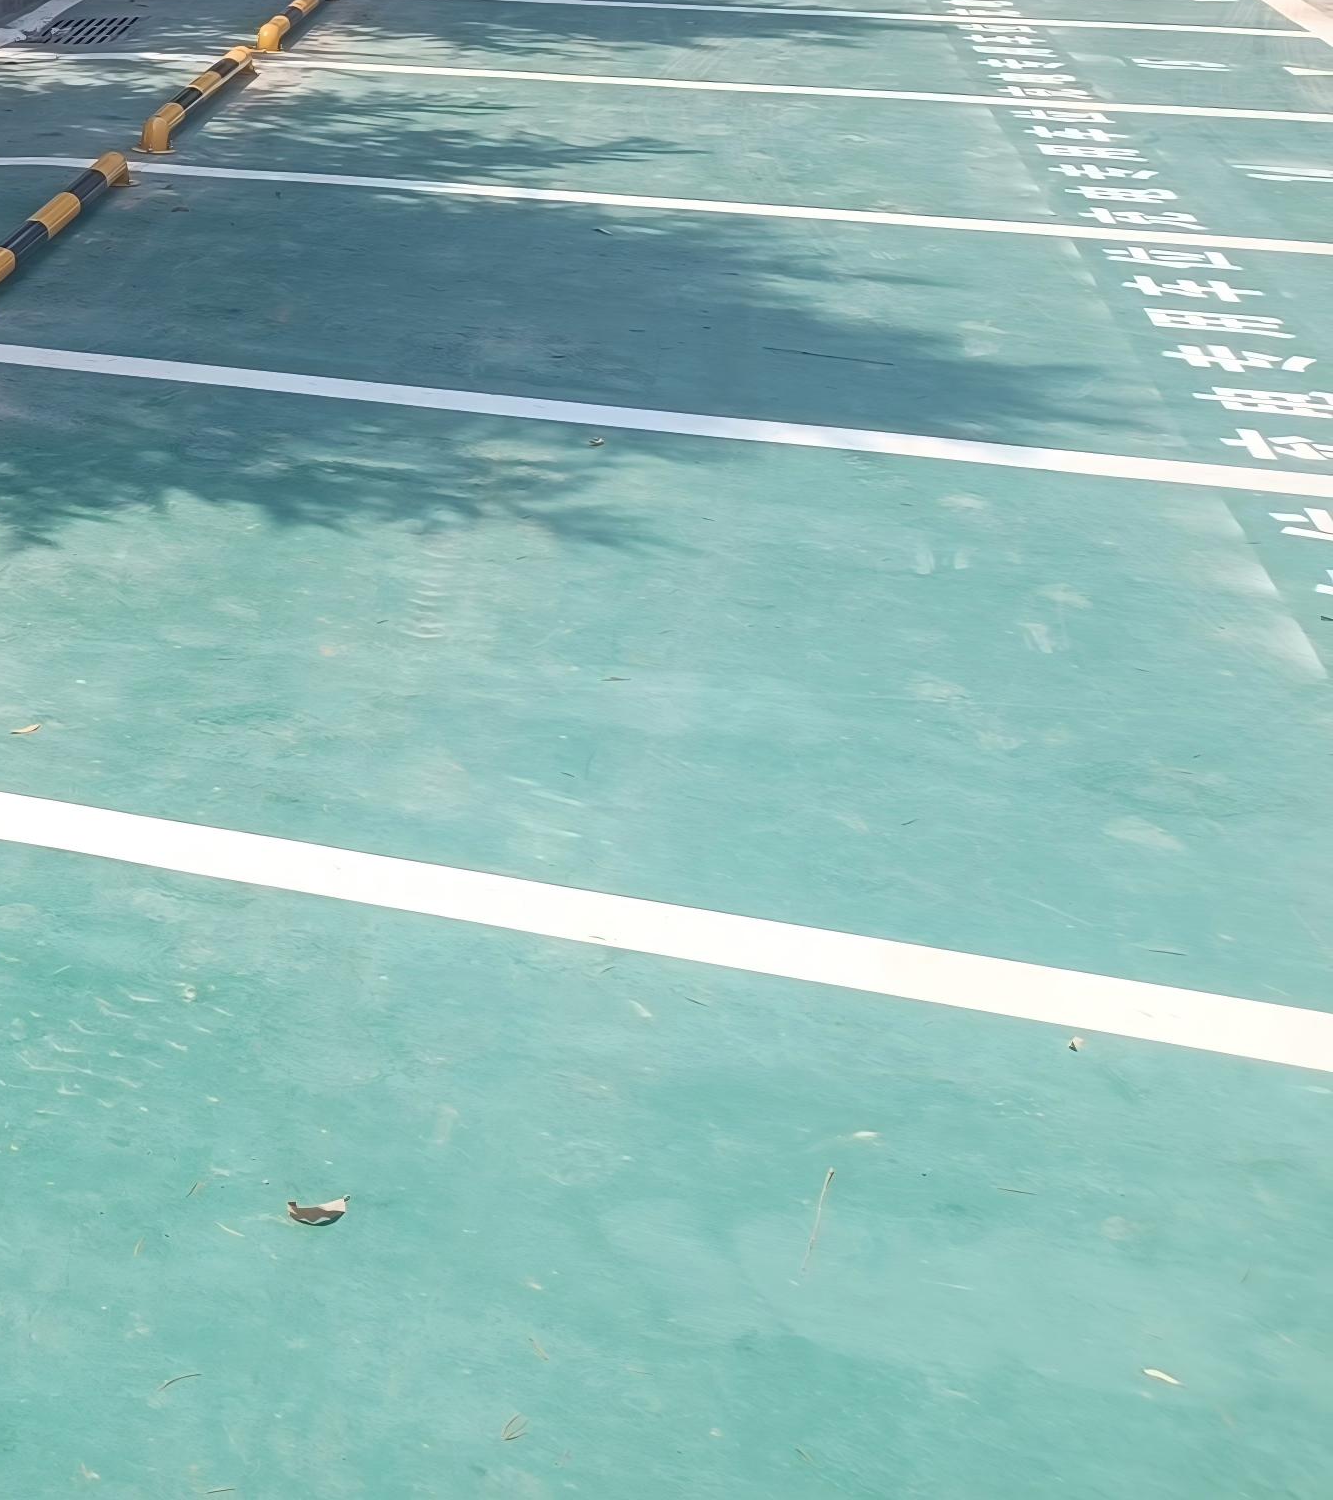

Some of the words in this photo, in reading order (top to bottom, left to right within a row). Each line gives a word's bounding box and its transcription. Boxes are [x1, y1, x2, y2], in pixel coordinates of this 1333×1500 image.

[1009, 108, 1210, 231] 充电专用车位
